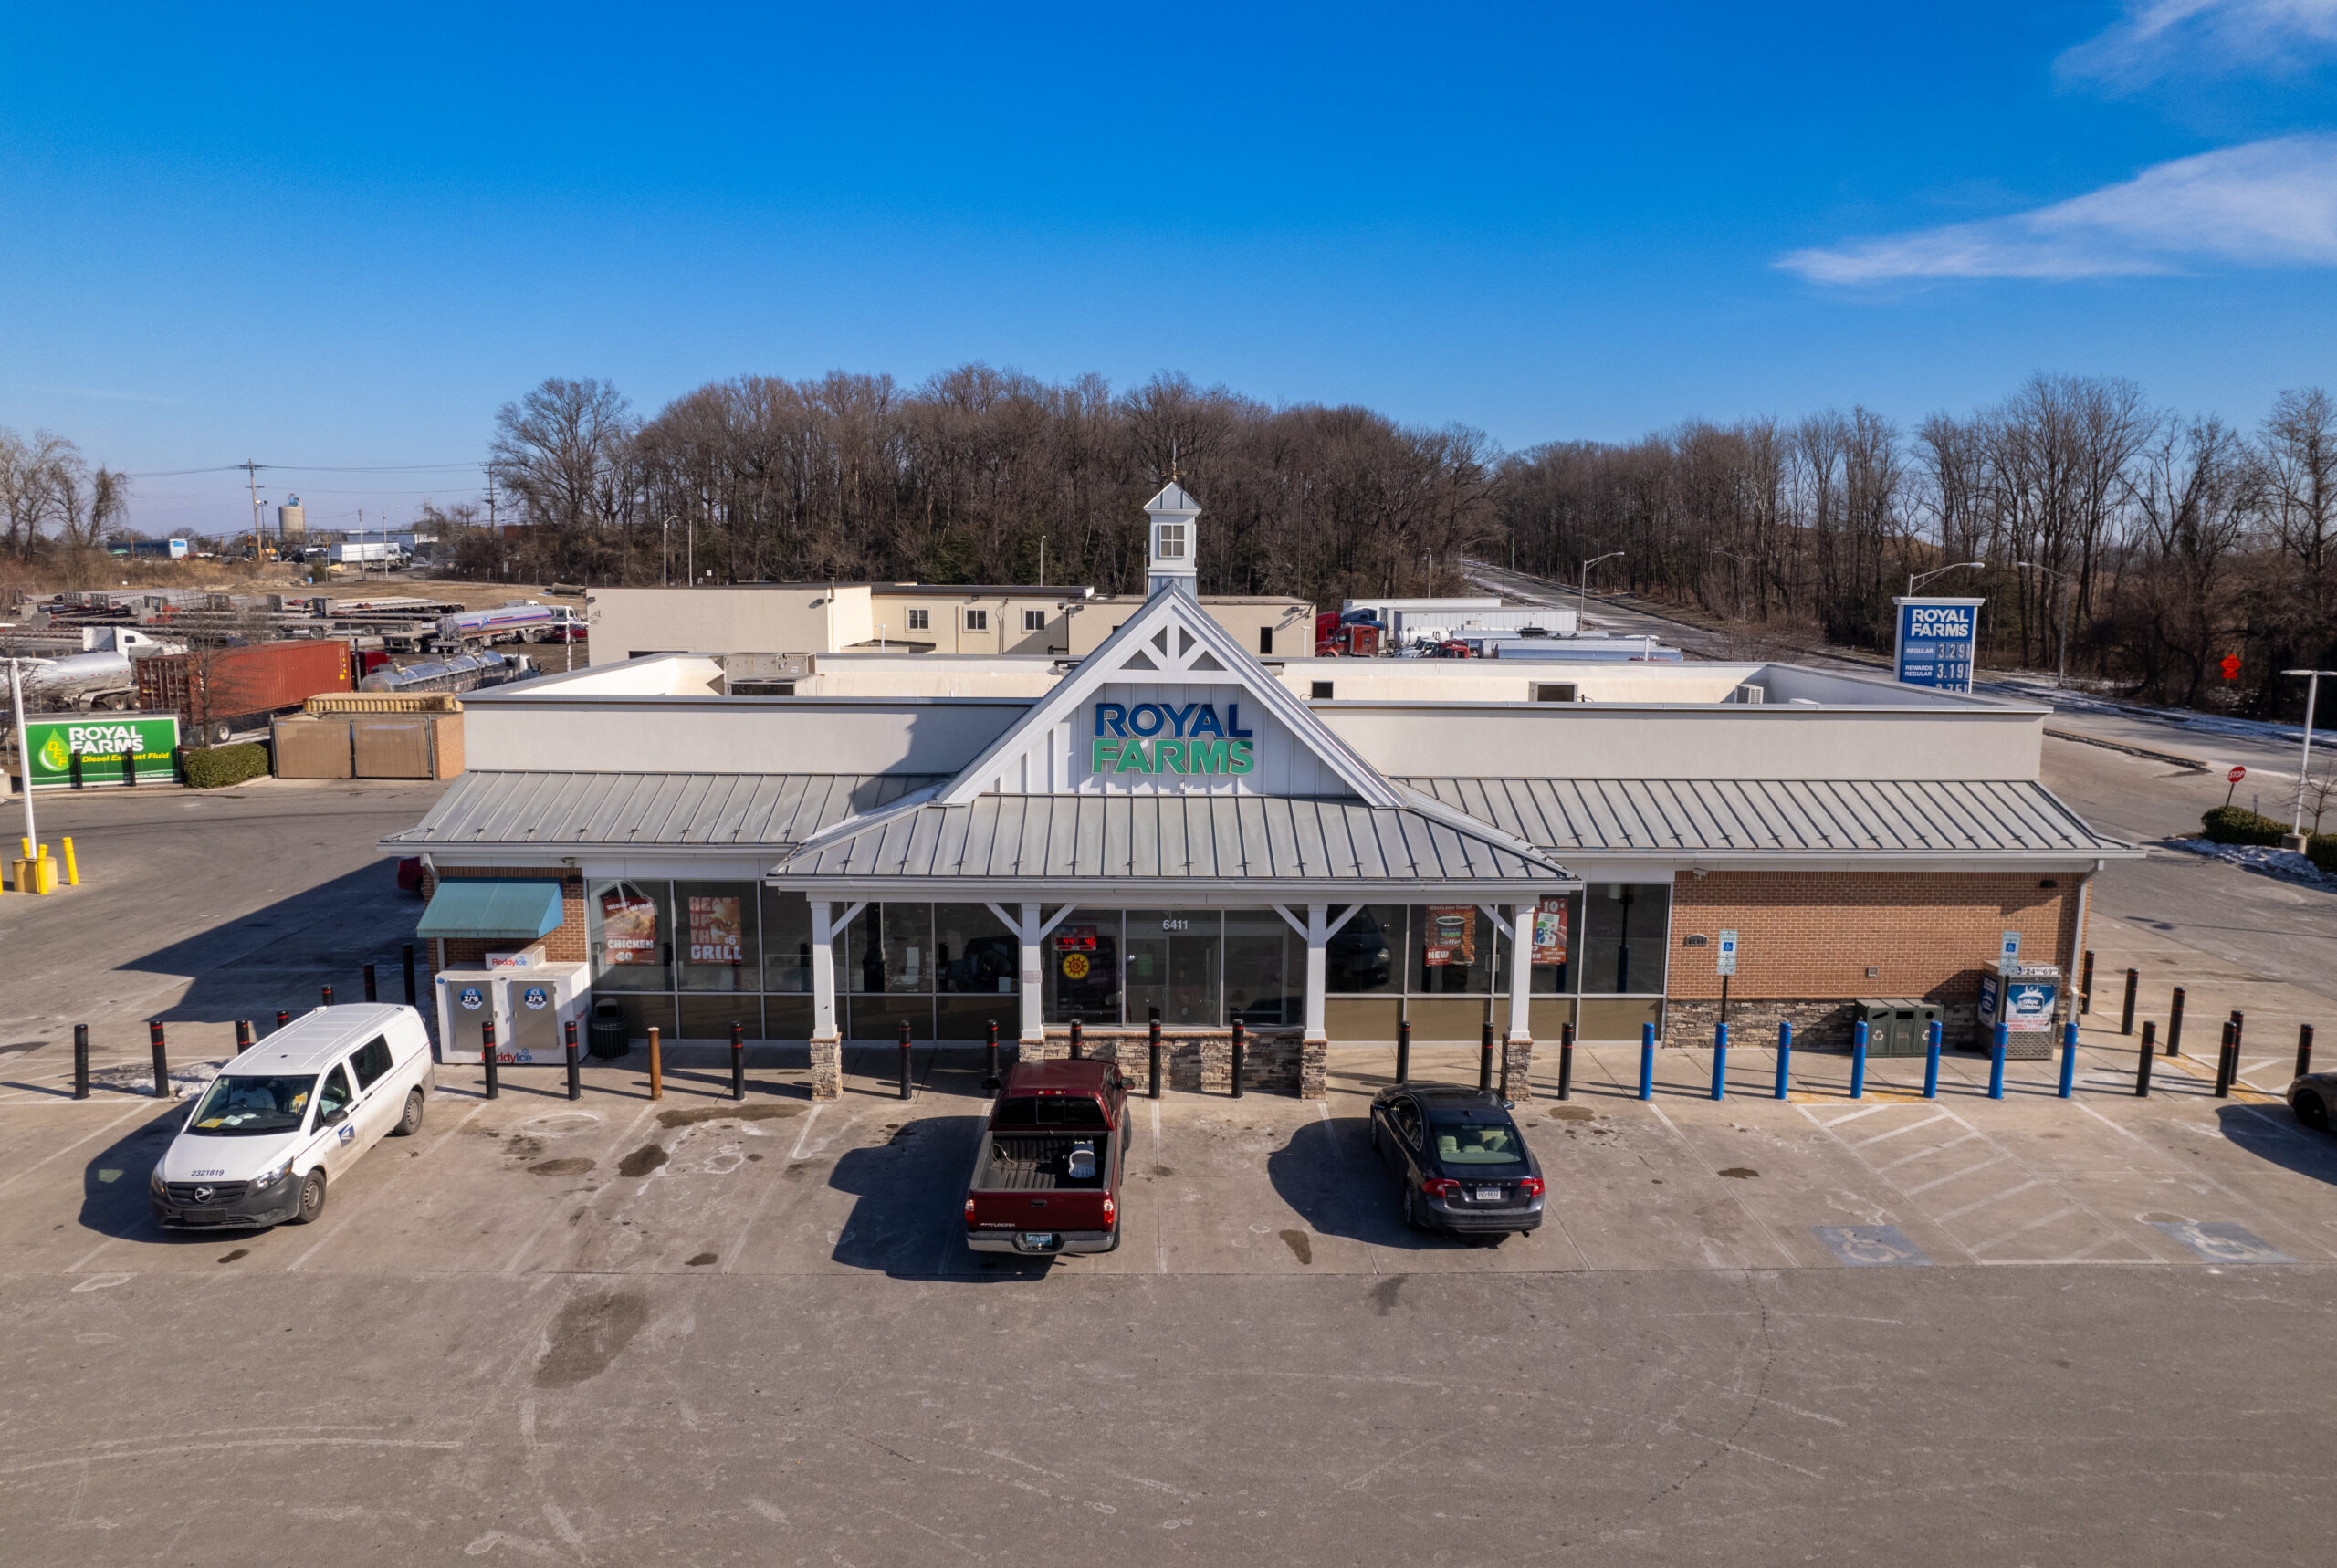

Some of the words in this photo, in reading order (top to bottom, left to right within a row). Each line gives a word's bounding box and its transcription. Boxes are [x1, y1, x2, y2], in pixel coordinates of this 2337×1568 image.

[1912, 609, 1969, 622] ROYAL
[1911, 623, 1968, 637] FARMS
[1938, 643, 1965, 659] 3.29
[1937, 664, 1964, 679] 3.19
[1094, 703, 1252, 738] ROYAL
[69, 725, 143, 741] ROYAL
[71, 739, 144, 754] FARMS
[1092, 739, 1254, 775] FARMS
[1163, 920, 1188, 930] 6411
[607, 939, 654, 949] CHICKEN
[1084, 937, 1095, 946] 46
[691, 944, 742, 960] GRILL
[1428, 951, 1449, 959] NEW
